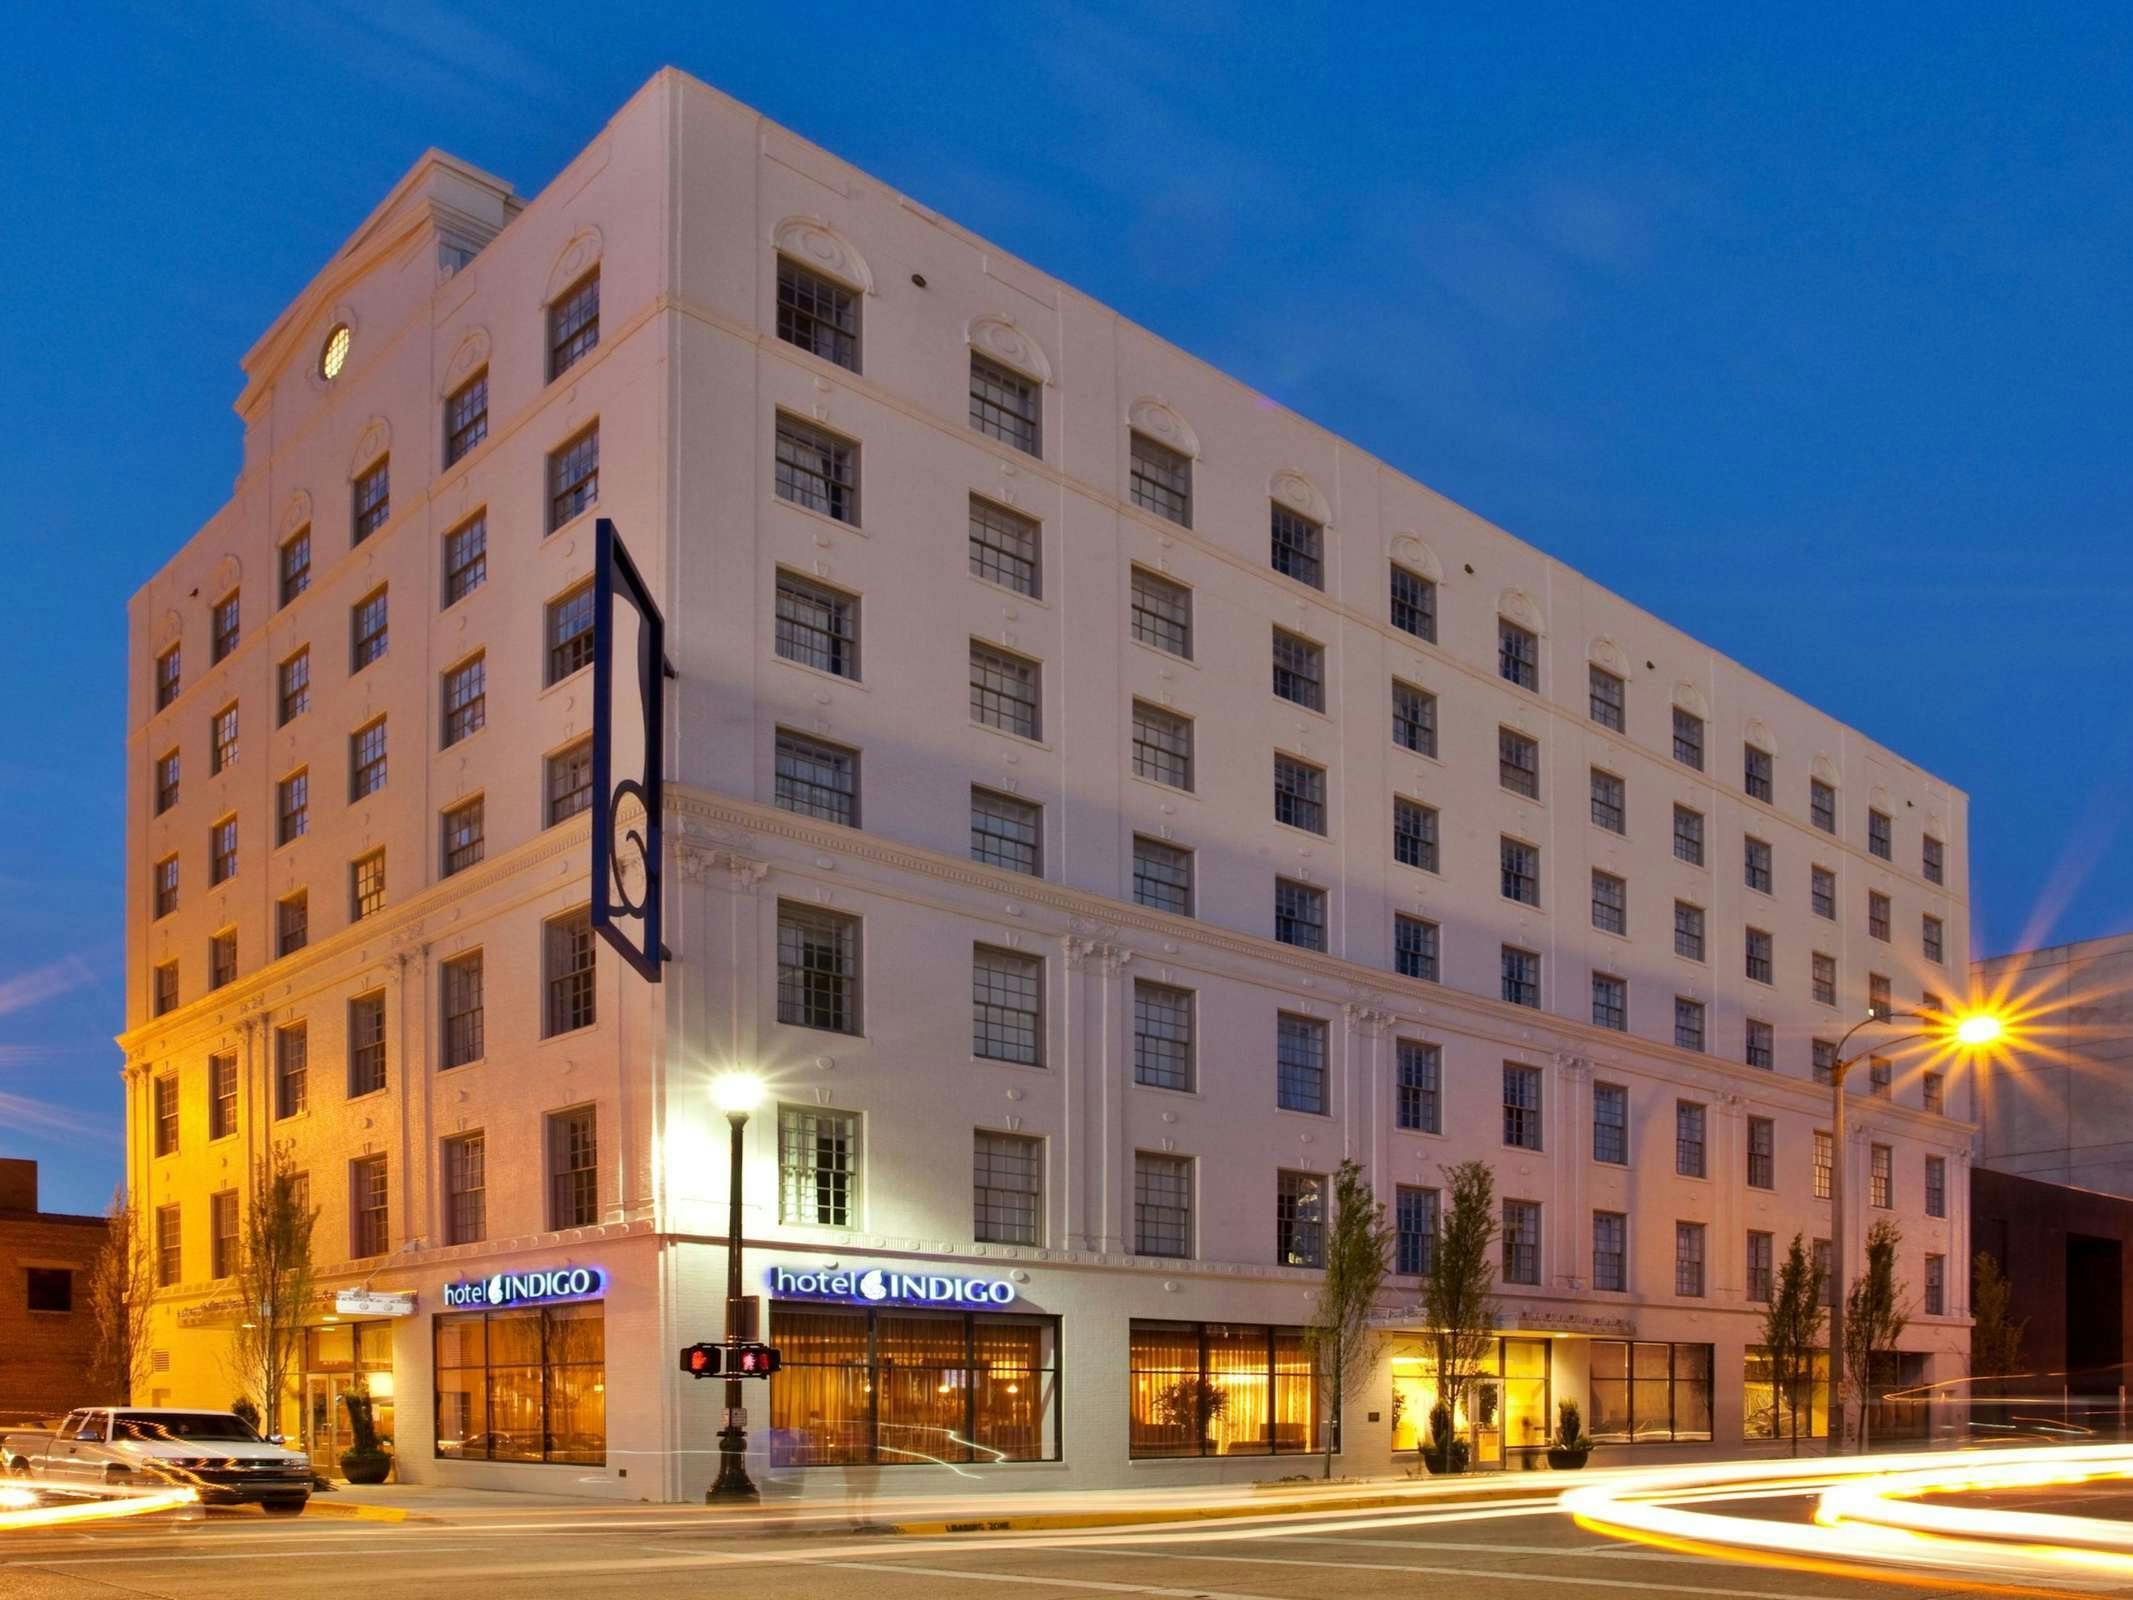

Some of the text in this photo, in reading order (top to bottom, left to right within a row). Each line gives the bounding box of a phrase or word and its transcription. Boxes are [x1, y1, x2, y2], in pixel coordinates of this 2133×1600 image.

[444, 1269, 590, 1306] hotel INDIGO
[777, 1267, 1015, 1304] hotel INDIGO
